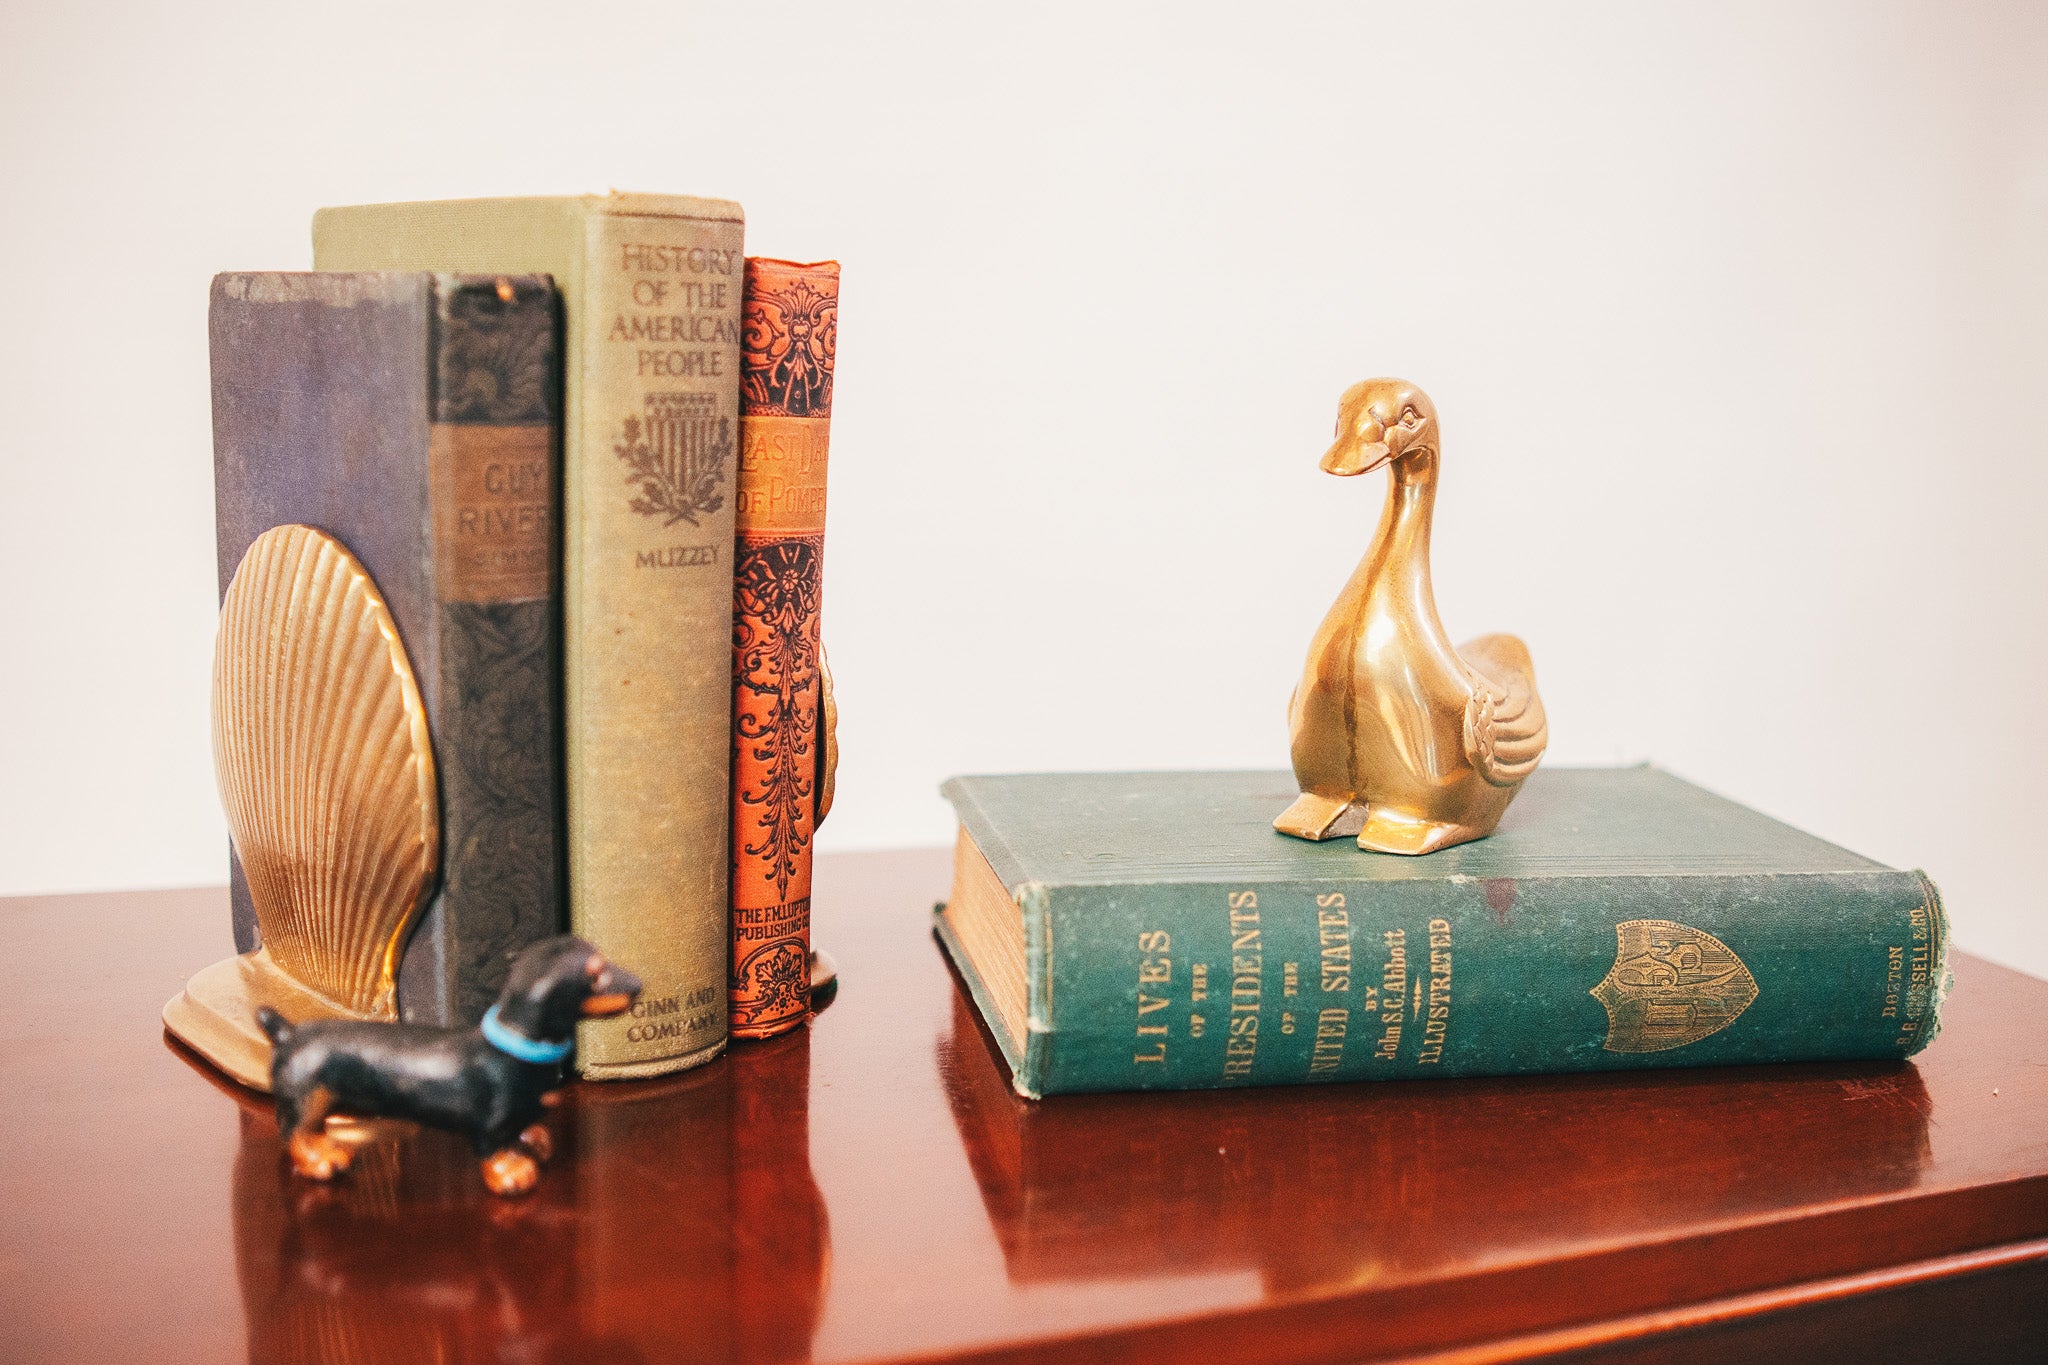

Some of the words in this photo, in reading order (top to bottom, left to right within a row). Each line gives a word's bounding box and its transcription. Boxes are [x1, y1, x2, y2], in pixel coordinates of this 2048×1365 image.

[620, 242, 737, 275] HISTORY
[632, 279, 670, 307] OF
[681, 281, 727, 309] THE
[607, 314, 739, 345] AMERICAN
[637, 349, 723, 378] PEOPLE
[484, 463, 546, 496] GUY
[737, 491, 764, 514] OF
[635, 544, 720, 569] MUZZEY
[735, 906, 763, 924] THE
[735, 918, 801, 942] PUBLISHING
[1315, 892, 1351, 992] STATES
[1191, 962, 1208, 1002] THE
[1283, 961, 1299, 997] THE
[1418, 917, 1452, 1065] ILLUSTRATED
[1881, 945, 1903, 1018] BOSTON
[686, 986, 715, 1010] AND
[1134, 929, 1172, 1065] LIVES
[1365, 985, 1379, 1012] BY
[626, 1007, 718, 1043] COMPANY
[1190, 1014, 1206, 1039] OF
[1281, 1012, 1296, 1035] OF
[1374, 1025, 1402, 1061] John
